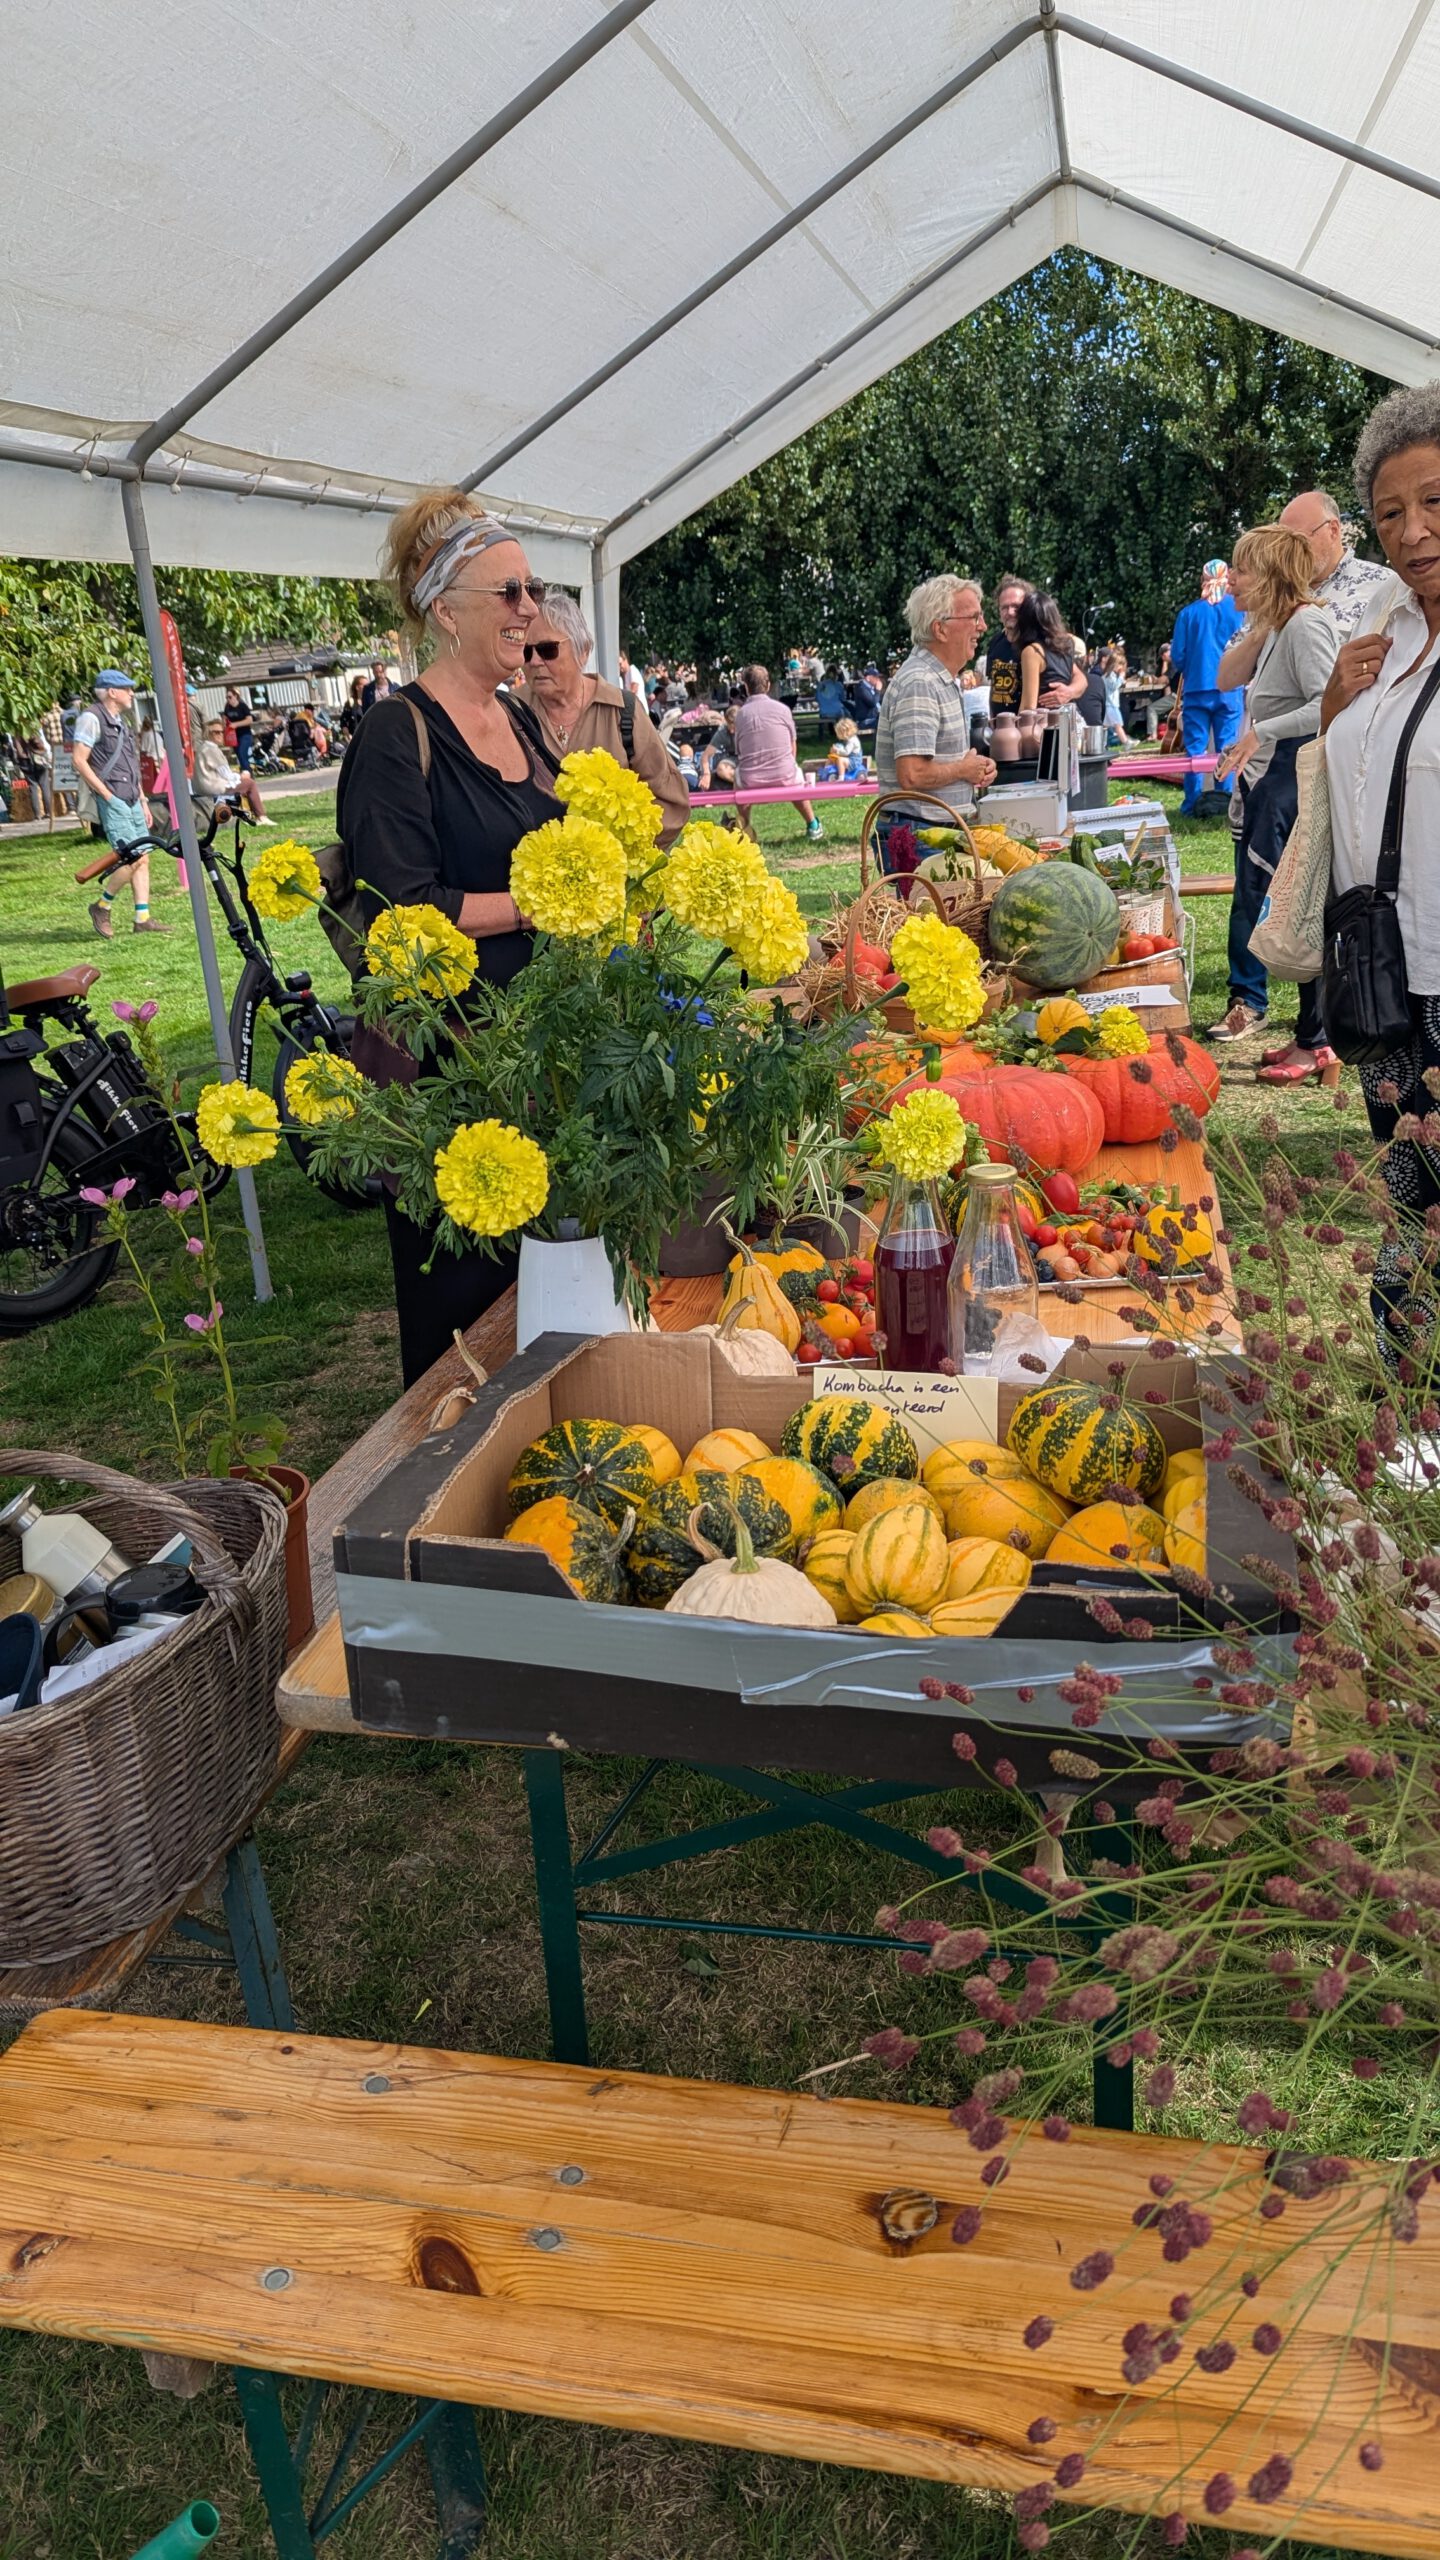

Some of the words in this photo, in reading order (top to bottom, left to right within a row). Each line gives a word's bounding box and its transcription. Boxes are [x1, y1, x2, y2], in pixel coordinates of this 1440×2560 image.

[239, 1000, 253, 1083] ikkefiets
[823, 1374, 905, 1393] Kombucha
[930, 1383, 959, 1394] een
